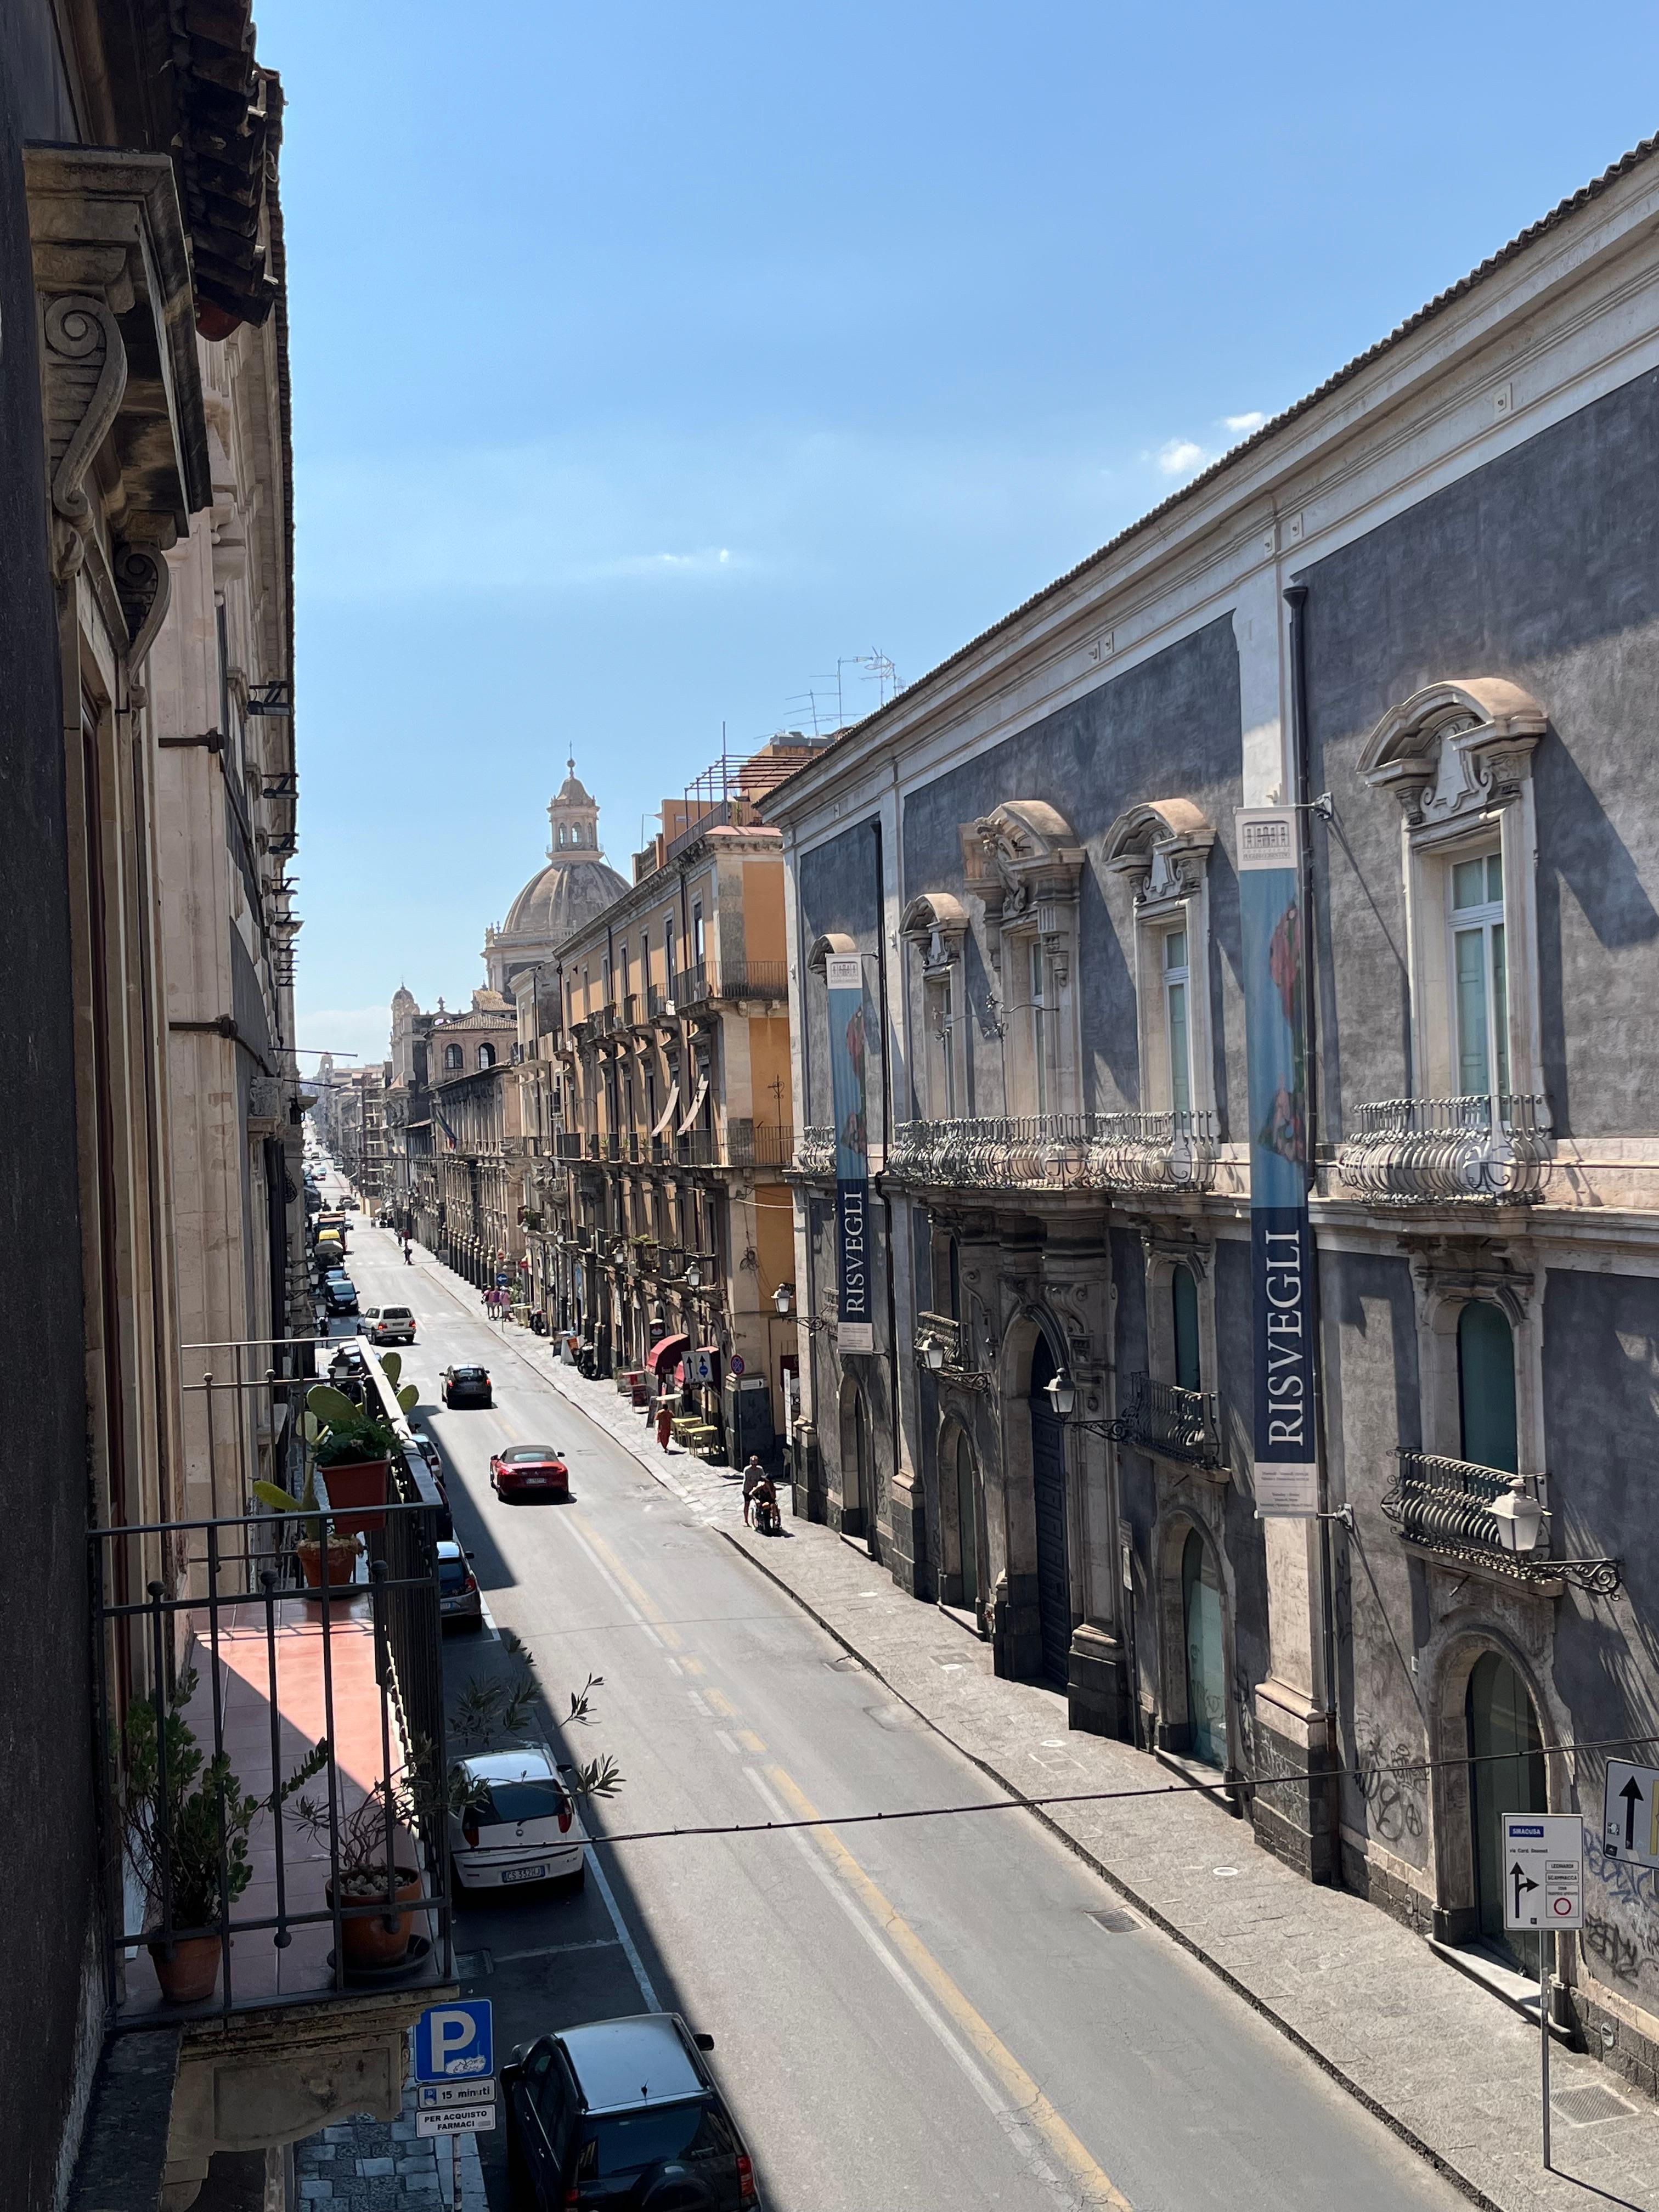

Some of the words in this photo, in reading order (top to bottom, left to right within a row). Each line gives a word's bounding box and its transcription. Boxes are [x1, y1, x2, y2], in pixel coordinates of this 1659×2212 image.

[844, 1192, 865, 1313] RISVEGLI
[1265, 1229, 1304, 1446] RISVEGLI
[431, 2010, 476, 2073] P
[442, 2091, 453, 2100] 15
[437, 2121, 475, 2131] FARMACI
[443, 2111, 488, 2121] ACQUISTO
